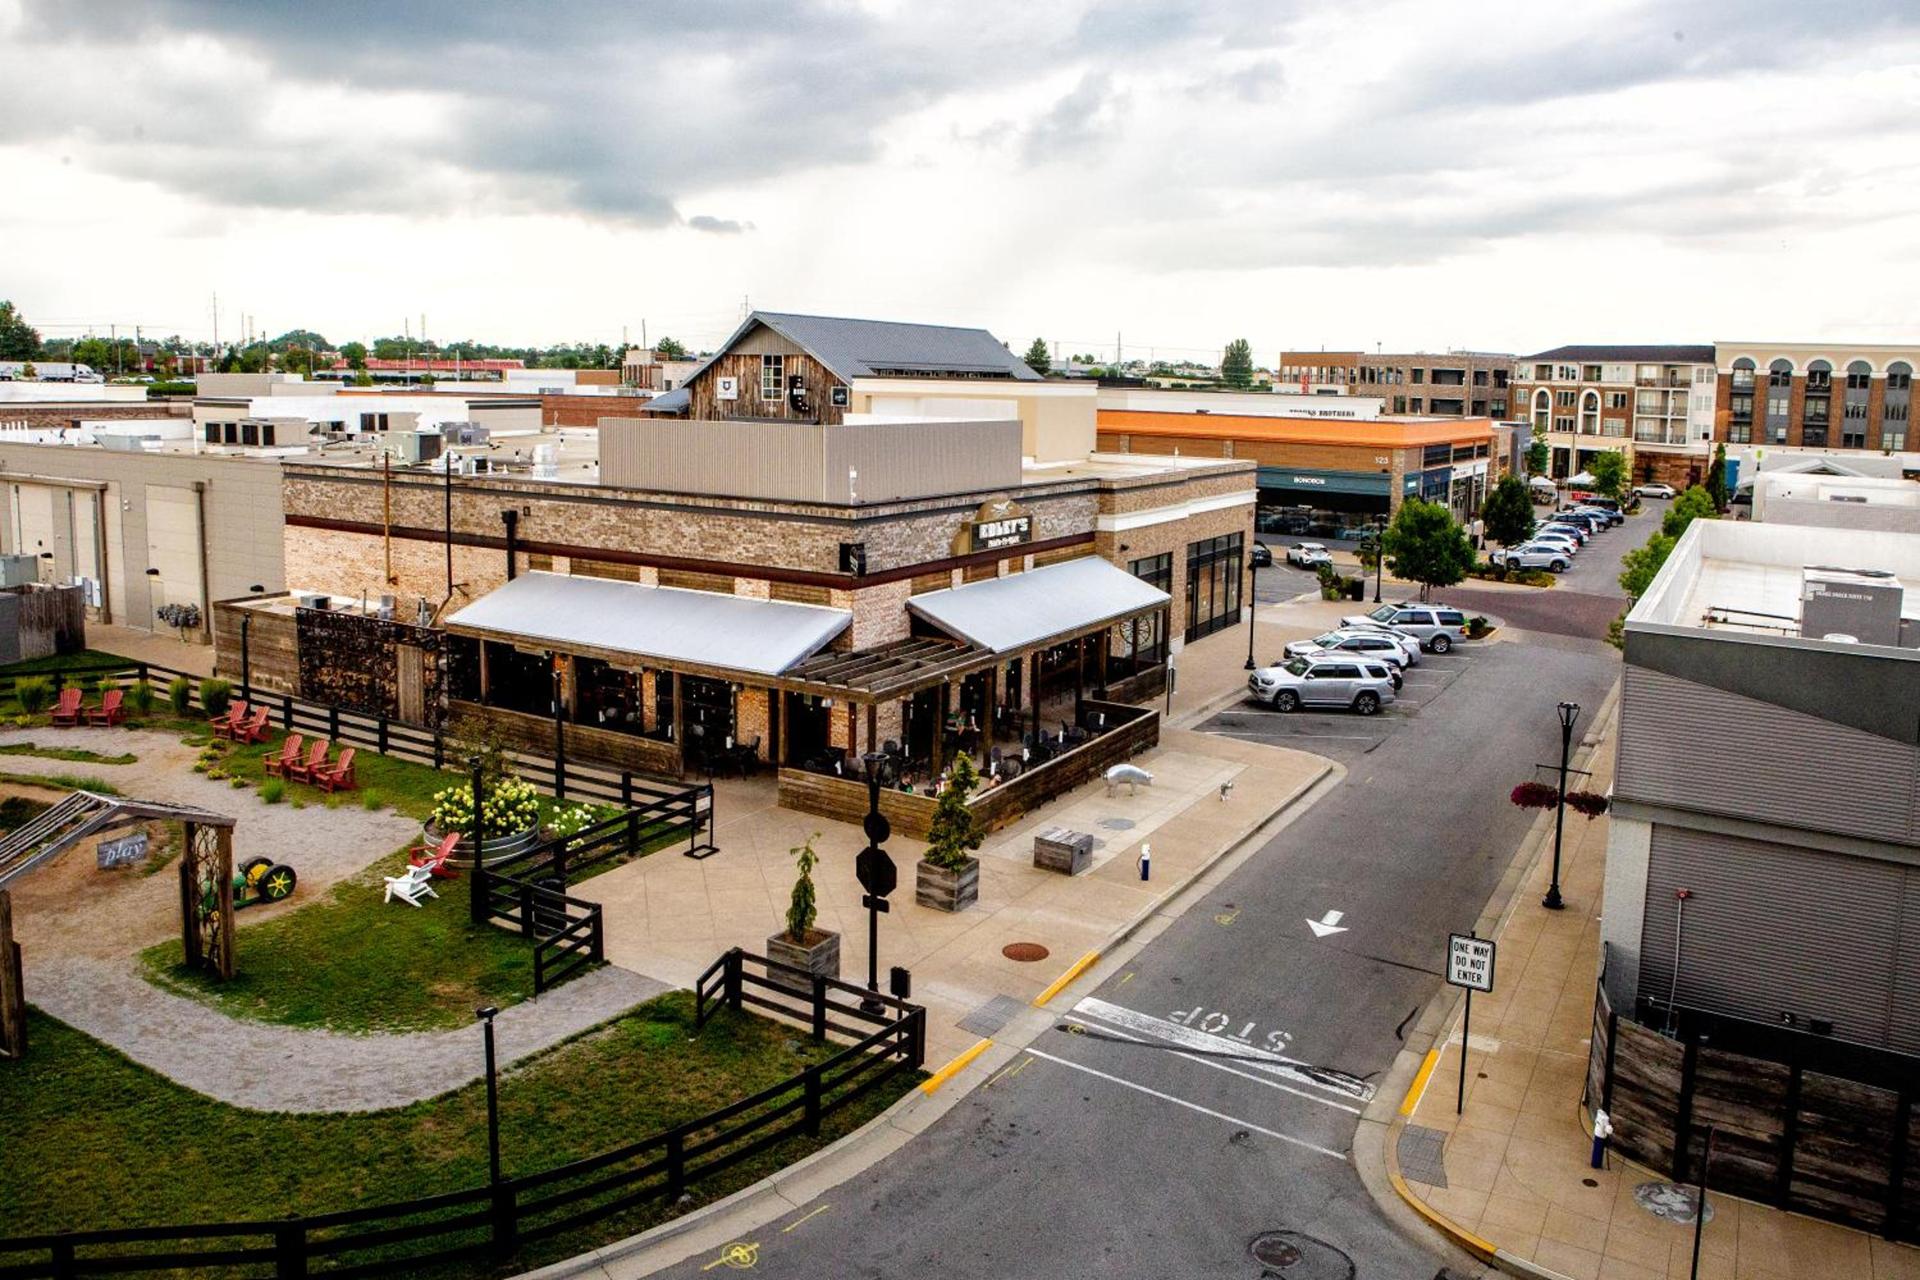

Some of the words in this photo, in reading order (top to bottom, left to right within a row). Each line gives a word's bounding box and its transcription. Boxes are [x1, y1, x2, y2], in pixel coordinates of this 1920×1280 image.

[105, 842, 143, 866] play
[1454, 942, 1470, 954] ONE
[1474, 946, 1489, 957] WAY
[1456, 956, 1466, 967] DO
[1470, 959, 1485, 970] NOT
[1458, 970, 1482, 983] ENTER
[1167, 1007, 1293, 1052] STOP
